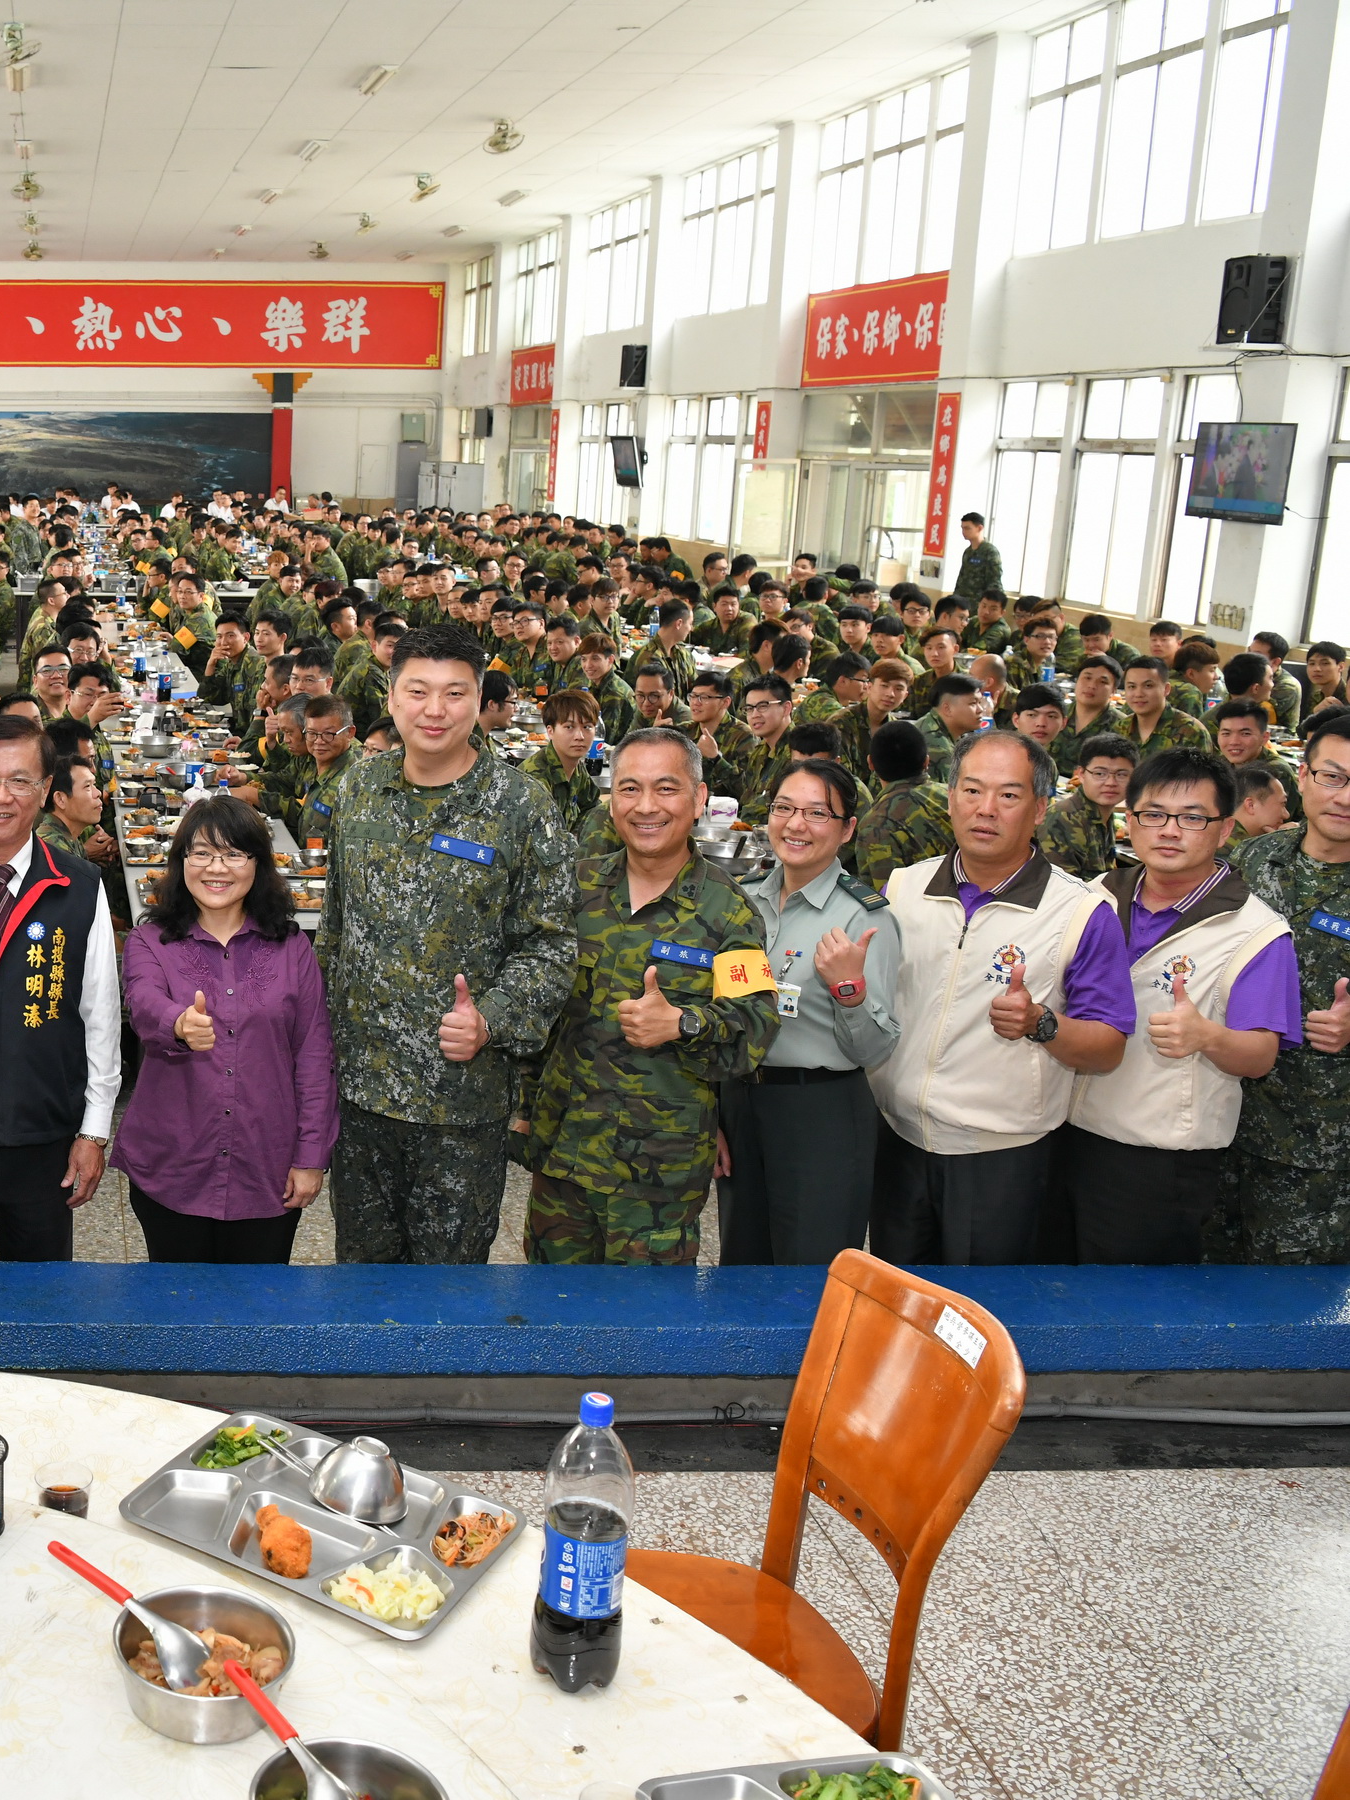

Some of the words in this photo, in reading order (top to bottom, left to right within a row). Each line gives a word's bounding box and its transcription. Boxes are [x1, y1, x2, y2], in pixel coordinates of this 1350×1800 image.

[22, 943, 47, 1029] 林明溱
[45, 926, 66, 1020] 南投縣縣長
[660, 945, 708, 964] 副旅長
